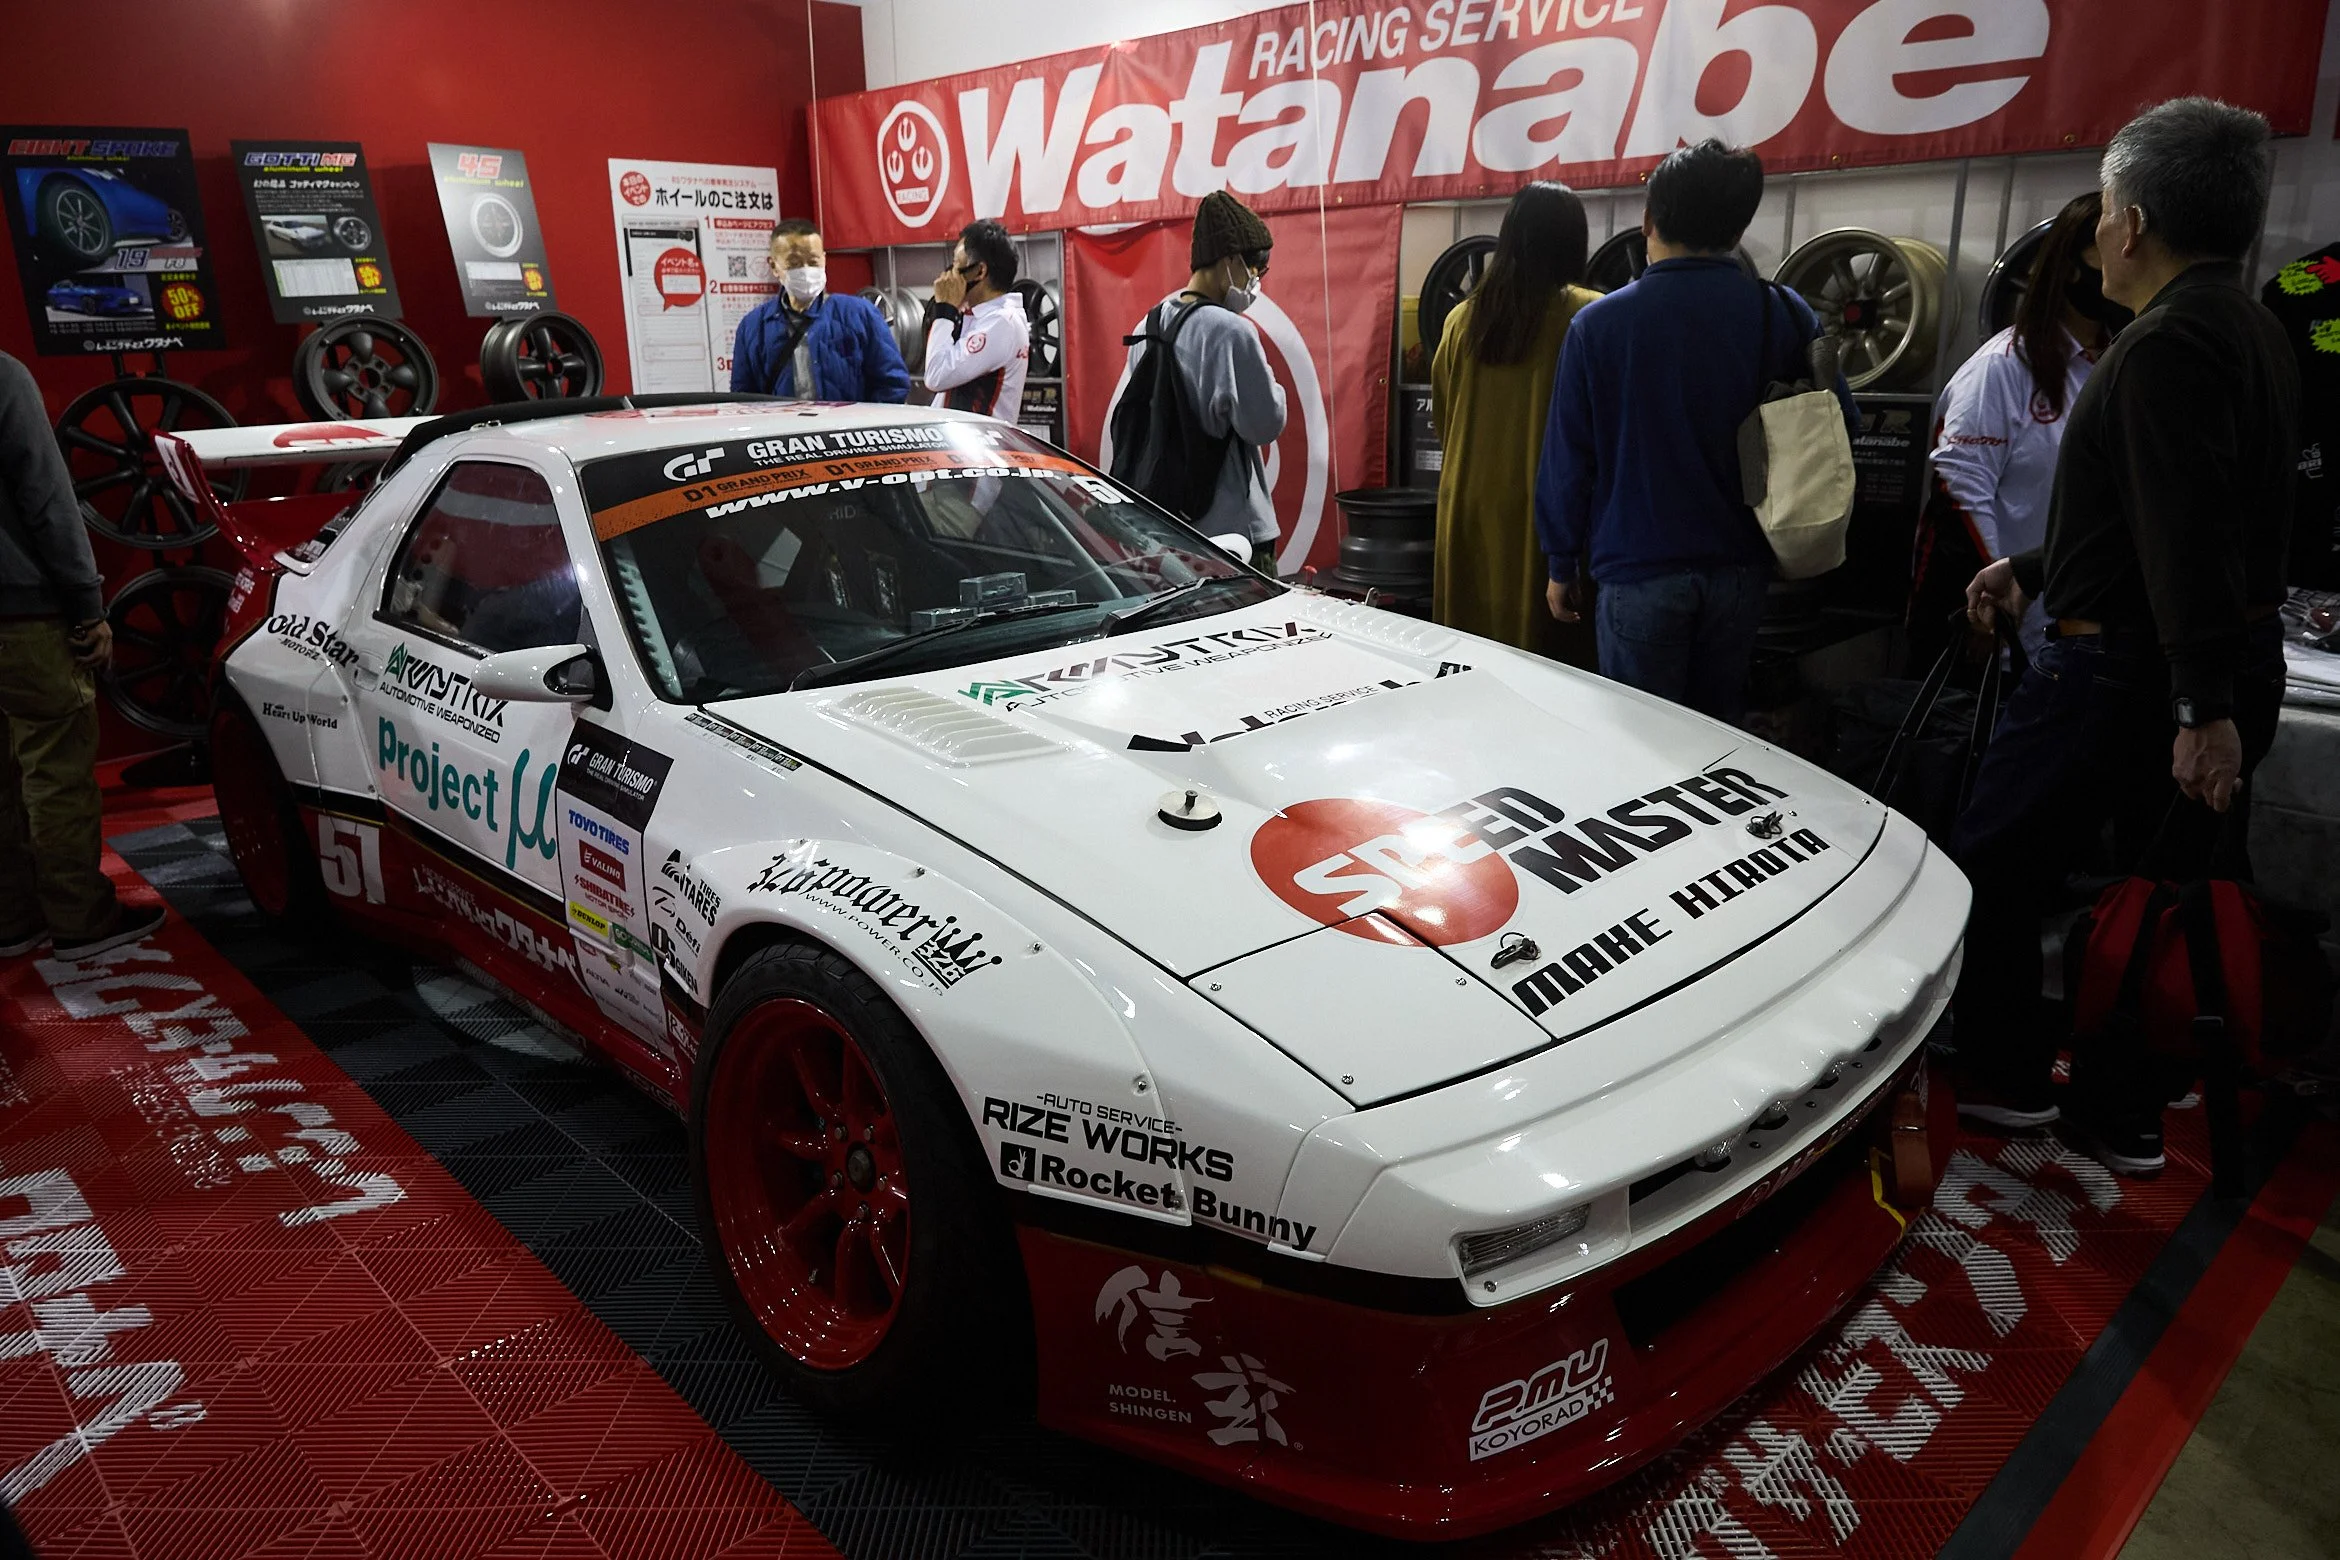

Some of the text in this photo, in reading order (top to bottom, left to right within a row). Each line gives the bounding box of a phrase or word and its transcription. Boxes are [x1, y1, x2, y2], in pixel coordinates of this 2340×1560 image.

[1248, 0, 1643, 79] RACING SERVICE
[958, 0, 2051, 220] Watanabe
[244, 152, 320, 166] GOTTI
[655, 187, 774, 211] ホイールのご注文は
[704, 216, 712, 229] 1
[114, 248, 151, 270] 19
[167, 287, 200, 306] 50%
[709, 280, 719, 294] 2
[174, 304, 201, 320] OFF
[717, 357, 725, 371] 3
[747, 435, 826, 460] GRAN
[829, 427, 944, 449] TURISMO
[753, 440, 950, 467] THE REAL DRIVING SIMULATOR
[824, 462, 856, 477] D1
[854, 458, 902, 471] GRAND
[902, 455, 933, 466] PRIX
[683, 469, 807, 502] D1 GRAND PRIX
[1070, 475, 1135, 504] 51
[268, 615, 359, 668] Old Star
[380, 681, 500, 743] AUTOMOTIVE WEAPONIZED
[1264, 684, 1380, 719] RACING SERVICE
[292, 711, 306, 724] Up
[306, 714, 338, 729] World
[589, 752, 616, 776] GRAN
[616, 763, 655, 794] TURISMO
[568, 809, 630, 856] TOYO TIRES
[1508, 767, 1790, 895] MASTER
[318, 815, 385, 905] 51
[591, 856, 621, 880] VALINO
[1293, 785, 1568, 920] SPEED
[699, 879, 721, 909] TIRES
[577, 910, 606, 930] DUNLOP
[1512, 826, 1831, 1019] MAKE HIROTA
[982, 1096, 1234, 1182] RIZE WORKS
[1040, 1153, 1317, 1251] Rocket Bunny
[1109, 1401, 1192, 1424] SHINGEN
[1474, 1400, 1584, 1456] KOYORAD
